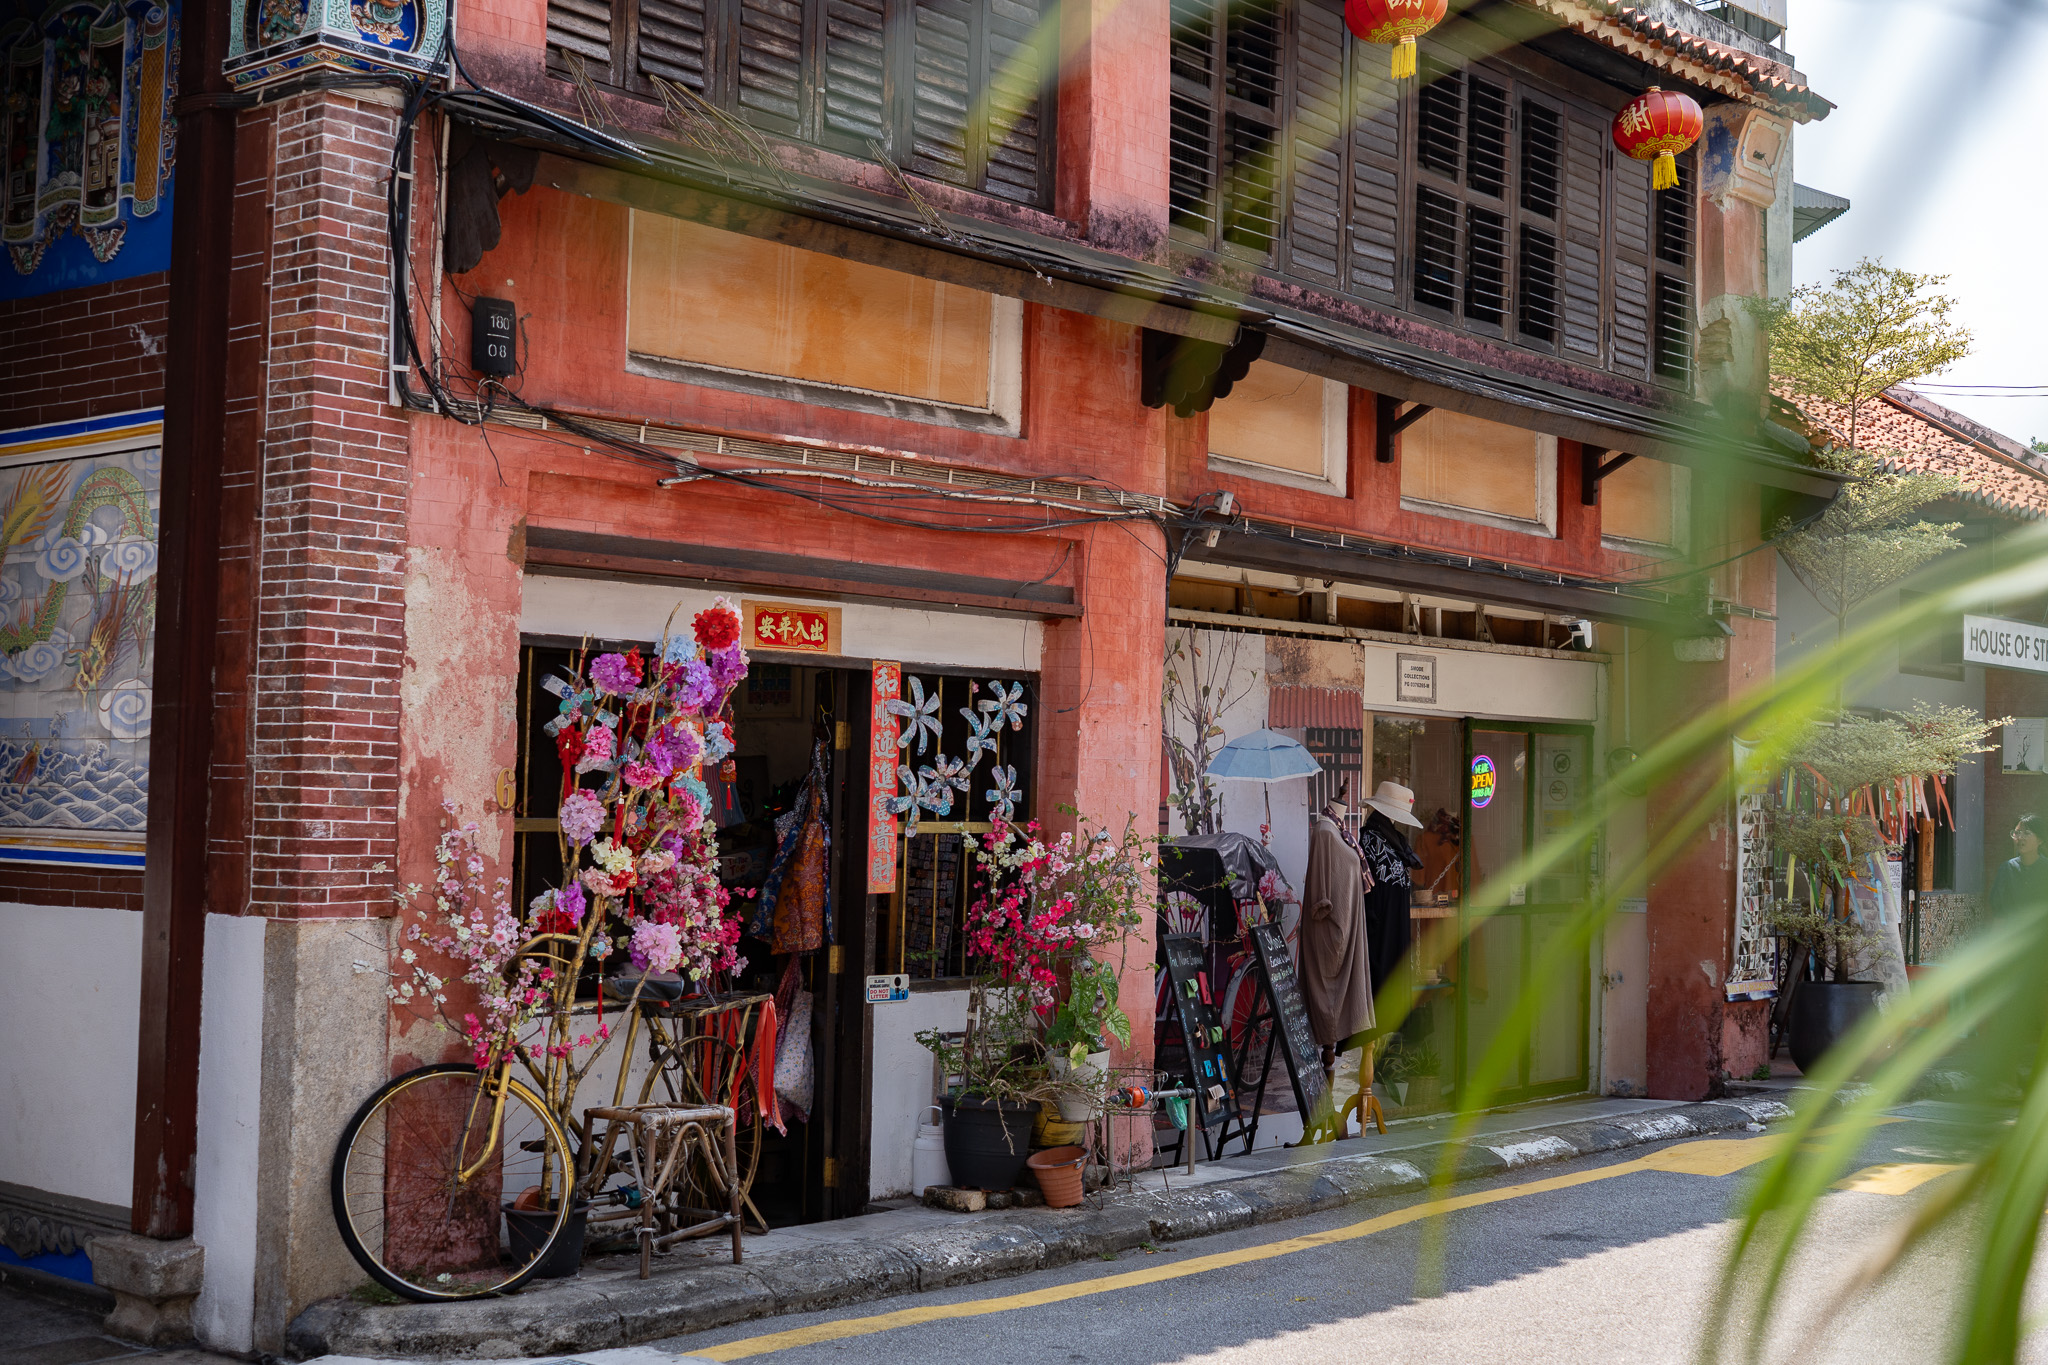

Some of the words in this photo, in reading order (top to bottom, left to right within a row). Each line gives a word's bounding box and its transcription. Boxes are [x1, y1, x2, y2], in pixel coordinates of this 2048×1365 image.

[490, 315, 510, 330] 180
[488, 344, 507, 358] 08
[1970, 626, 2012, 657] HOUSE
[2014, 634, 2030, 659] OF
[496, 767, 516, 810] 6
